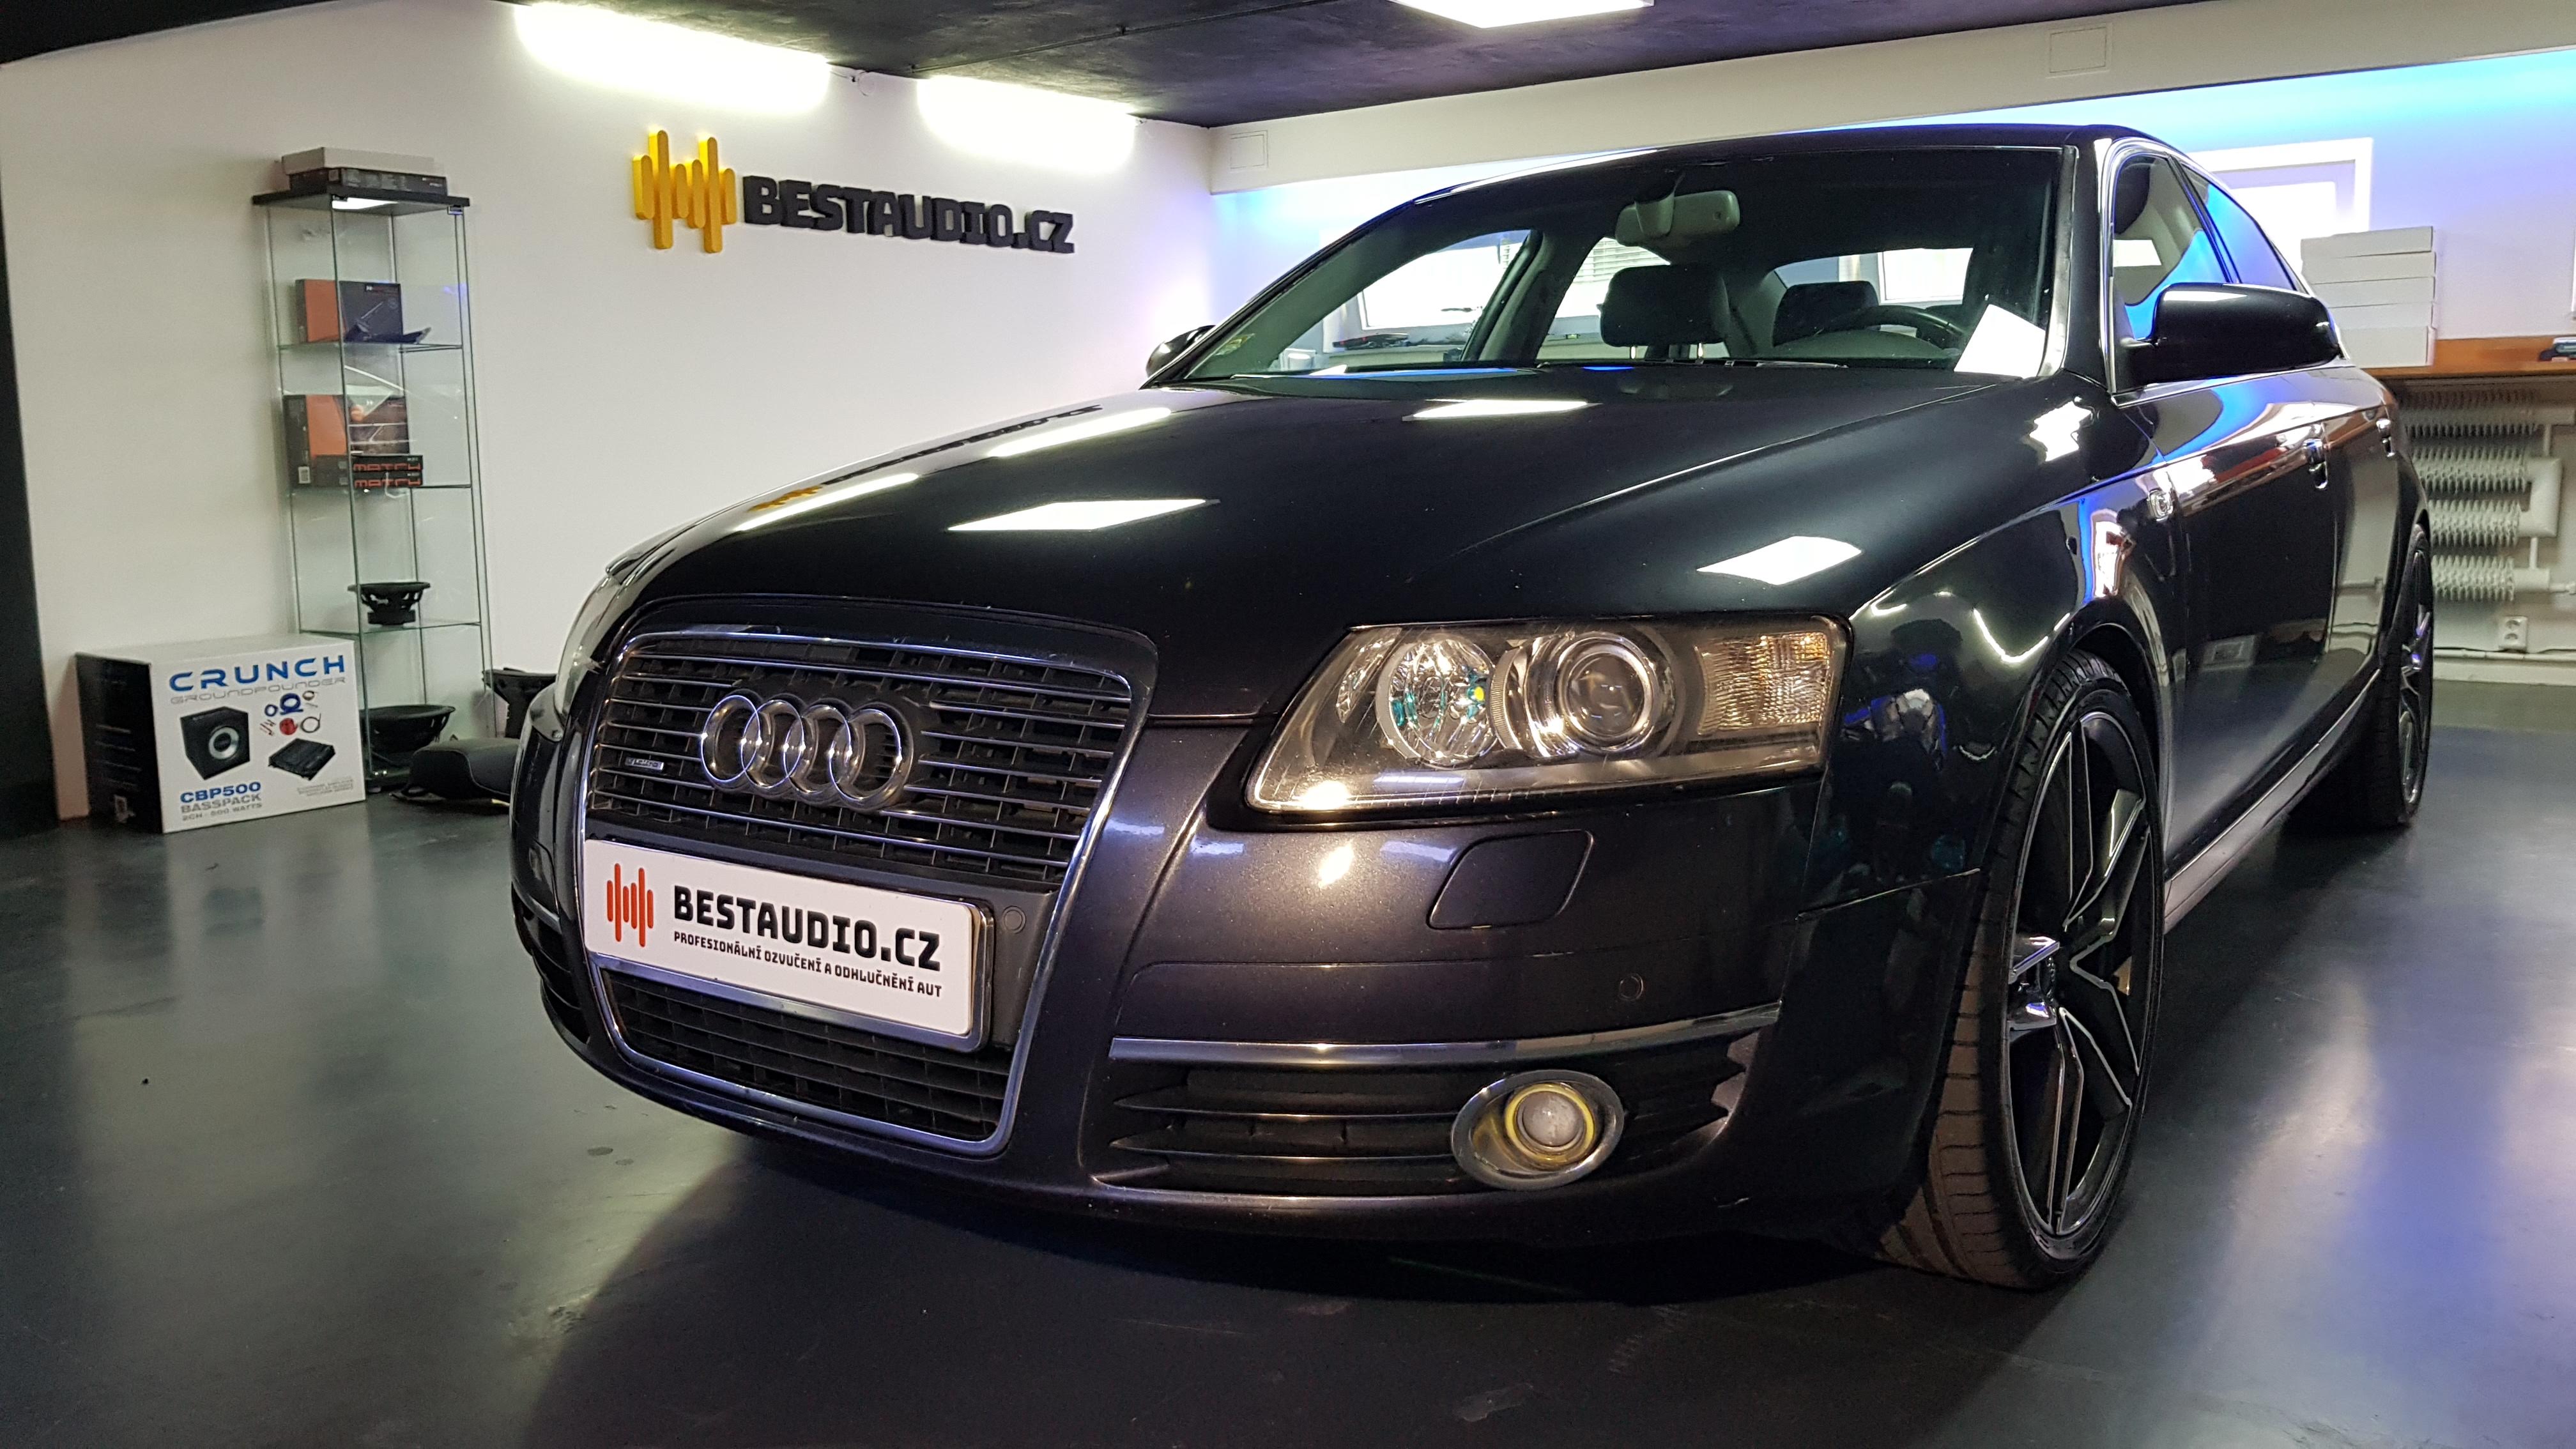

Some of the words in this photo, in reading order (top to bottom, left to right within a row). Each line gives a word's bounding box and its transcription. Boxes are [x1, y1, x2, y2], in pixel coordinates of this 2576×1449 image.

[743, 175, 1075, 253] BESTAUDIO.CZ
[169, 655, 345, 692] CRUNCH
[170, 677, 346, 705] GROUNDPOUNDER
[180, 781, 261, 803] CBP500
[181, 793, 262, 814] BASSPACK
[233, 802, 263, 811] WATTS
[675, 885, 940, 972] BESTAUDIO.CZ
[675, 931, 762, 960] PROFESIONÁLNÍ
[764, 949, 822, 973] OZVUČENÍ
[824, 962, 832, 975] A
[834, 965, 914, 992] ODHLUČNĚNÍ
[917, 981, 942, 997] AUT
